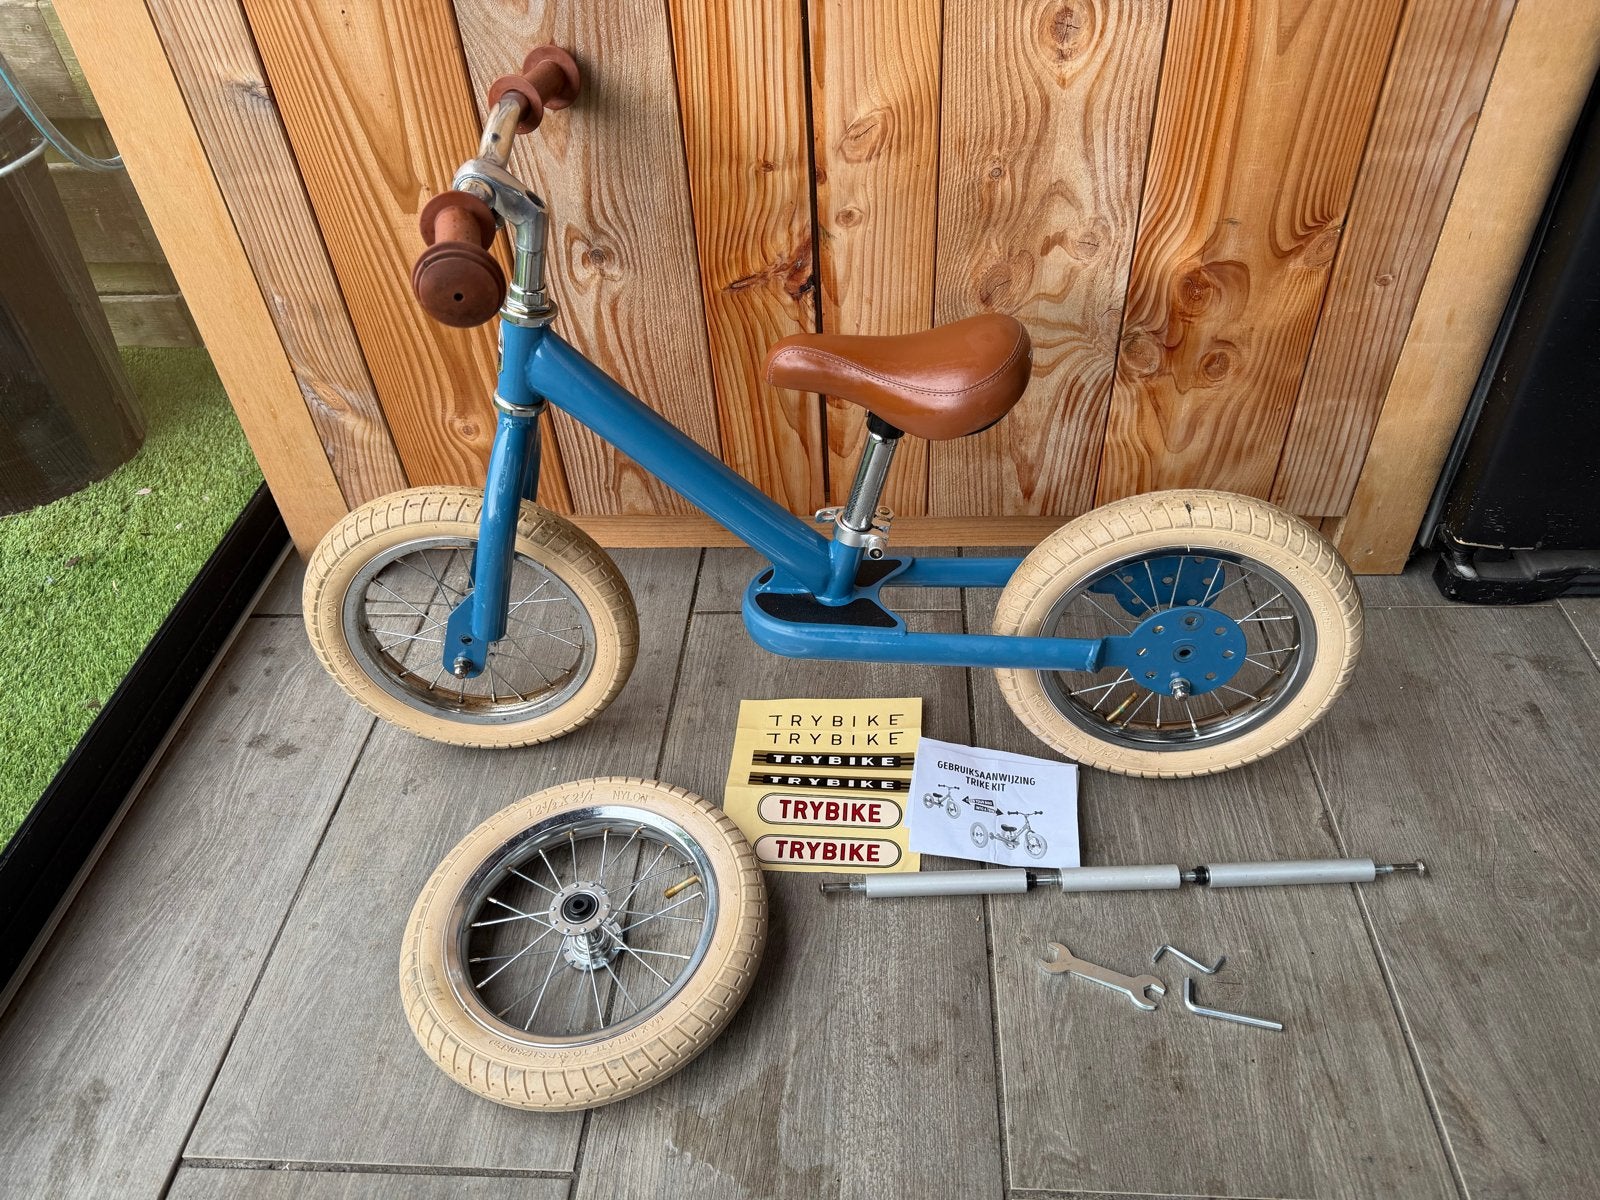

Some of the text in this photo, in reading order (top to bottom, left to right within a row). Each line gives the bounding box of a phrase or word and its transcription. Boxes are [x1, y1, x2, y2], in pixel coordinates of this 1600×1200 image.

[769, 714, 903, 727] TRYBIKE
[767, 732, 903, 745] TRYBIKE
[773, 755, 894, 766] TRYBIKE
[937, 760, 1036, 786] GEBRUIKSAANWIJZING
[770, 776, 894, 789] TRYBIKE
[966, 776, 1006, 792] TRIKE KIT
[779, 799, 882, 823] TRYBIKE
[776, 840, 880, 862] TRYBIKE
